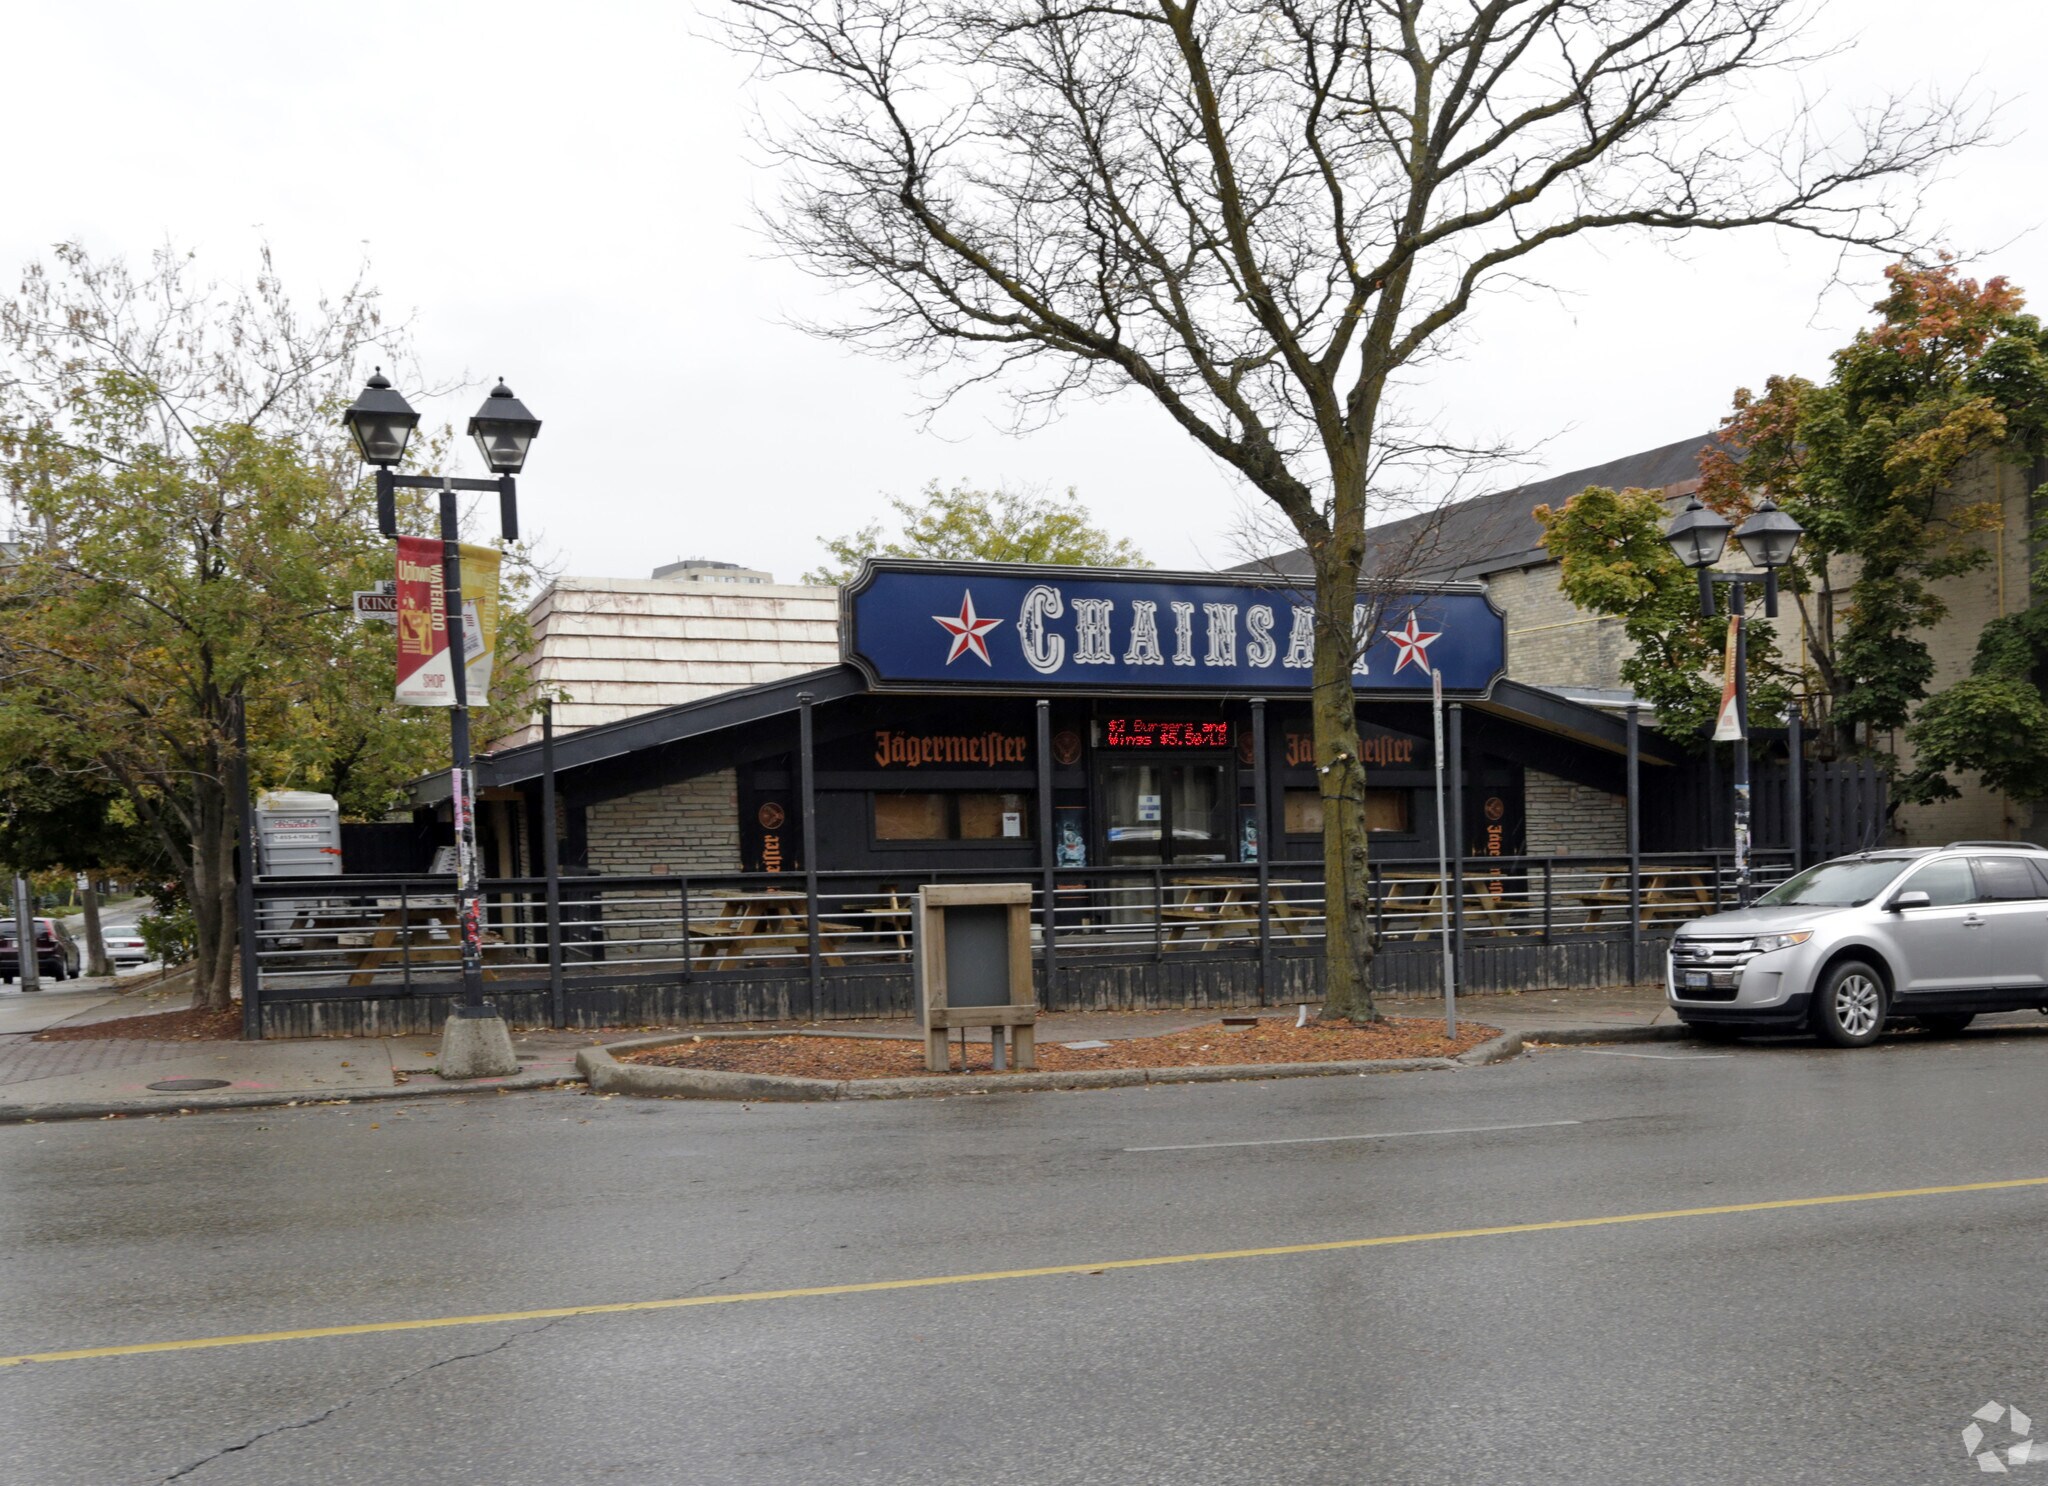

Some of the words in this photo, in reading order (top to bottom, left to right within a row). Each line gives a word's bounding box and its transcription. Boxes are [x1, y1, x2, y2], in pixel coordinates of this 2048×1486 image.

[361, 596, 398, 611] KING
[430, 564, 446, 631] WATERLOO
[423, 674, 446, 688] SHOP
[1133, 719, 1194, 732] Burgers
[1202, 721, 1227, 732] and
[1108, 732, 1152, 746] Wings
